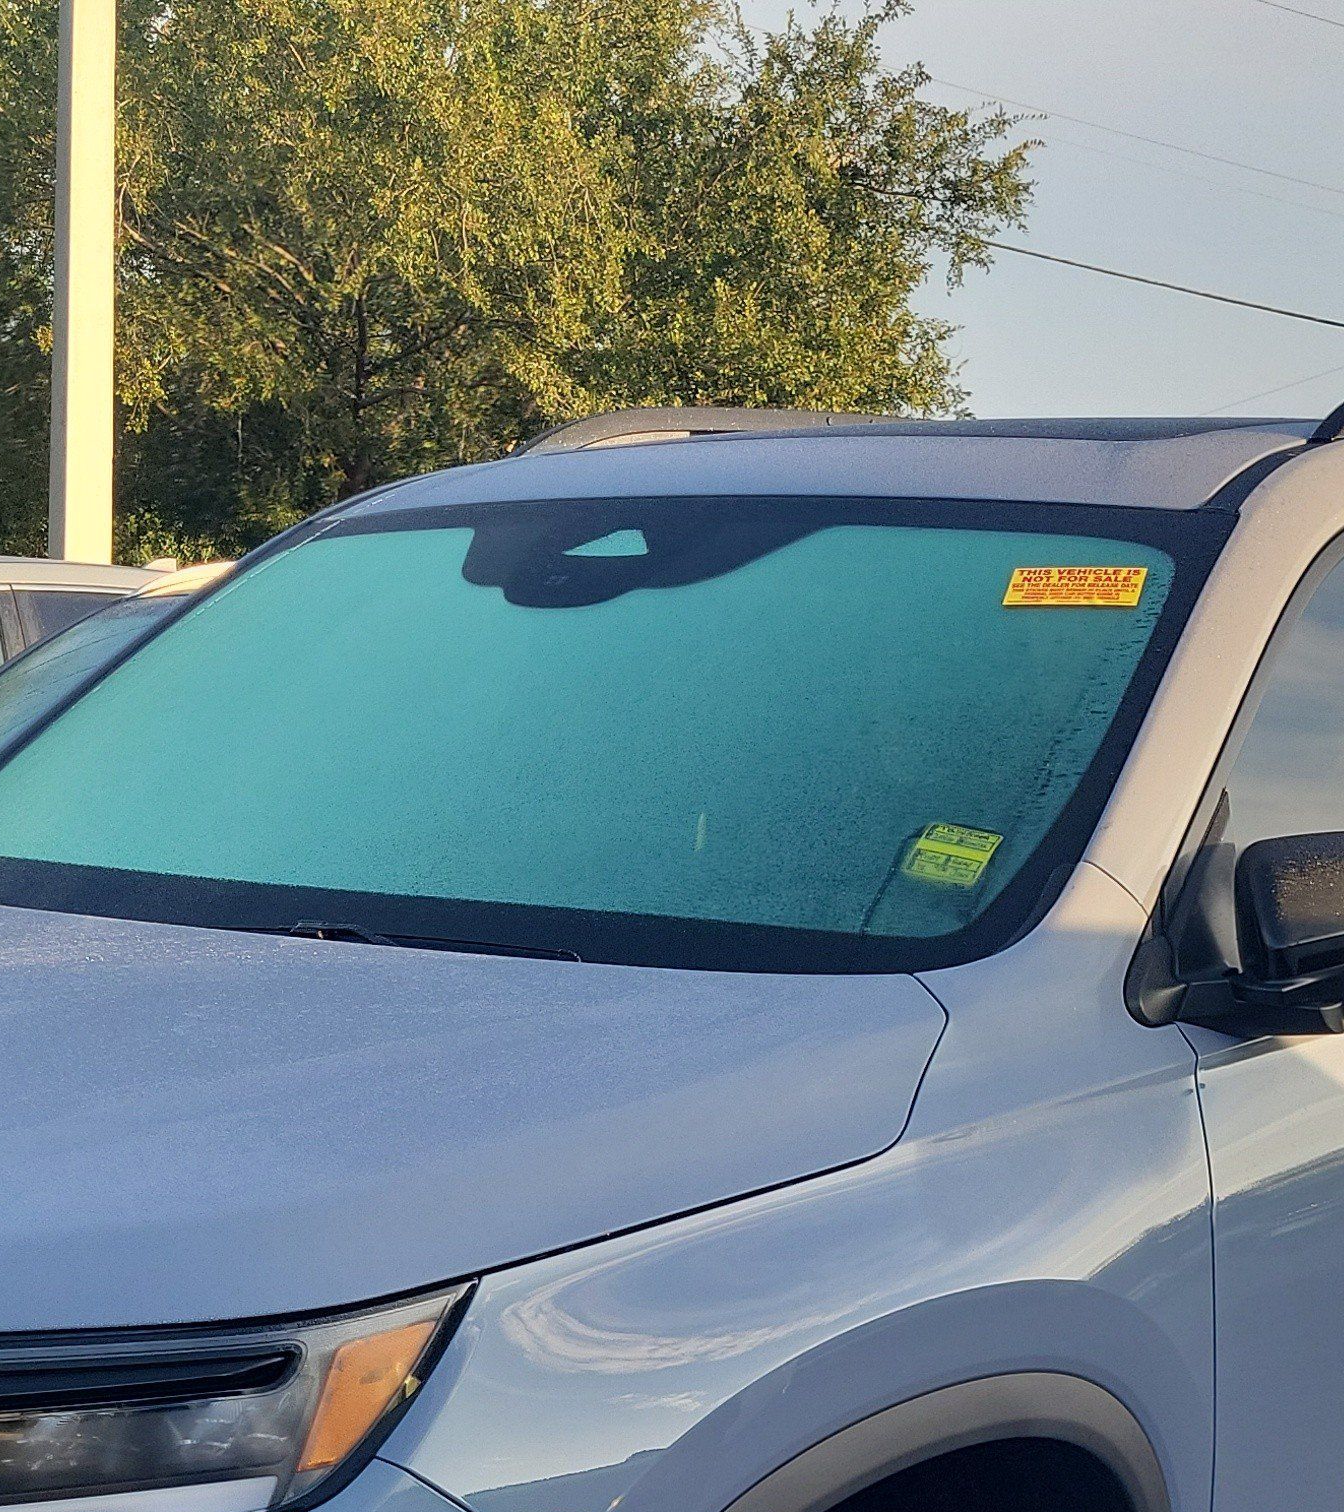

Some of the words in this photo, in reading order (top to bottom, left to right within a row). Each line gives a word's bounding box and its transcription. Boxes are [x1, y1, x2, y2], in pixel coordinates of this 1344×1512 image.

[1021, 575, 1055, 583] NOT
[1057, 575, 1089, 583] FOR
[1093, 575, 1132, 583] SALE
